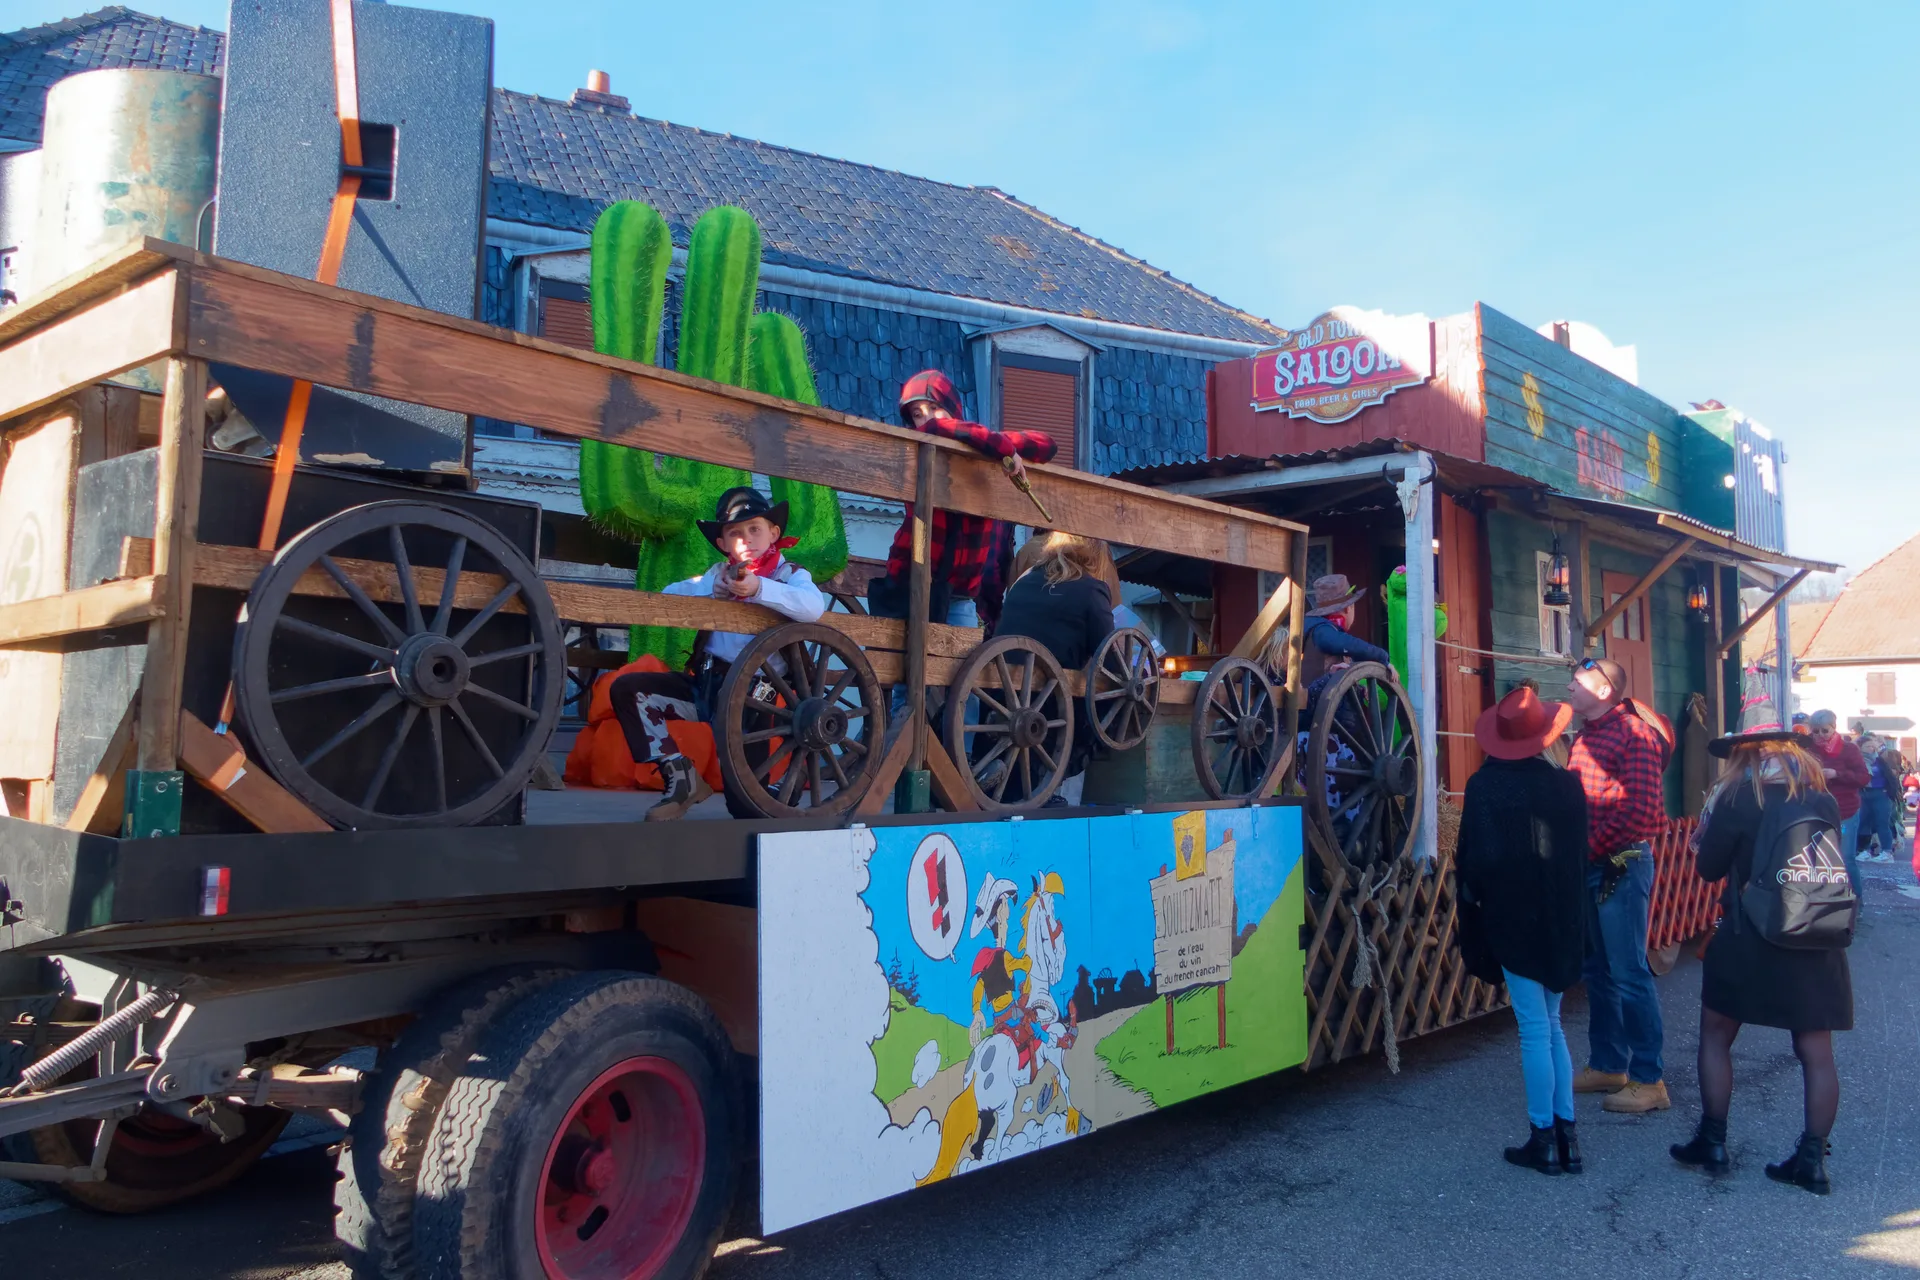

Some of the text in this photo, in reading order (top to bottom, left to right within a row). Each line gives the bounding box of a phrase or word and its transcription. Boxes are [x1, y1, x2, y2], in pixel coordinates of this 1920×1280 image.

[1298, 319, 1360, 350] OLD TO
[1319, 394, 1340, 405] BEER
[1342, 392, 1349, 401] &
[1351, 387, 1378, 399] GIRLS
[1776, 868, 1849, 885] adida
[1162, 876, 1223, 938] SOULTZMATT
[1177, 945, 1187, 957] de
[1179, 956, 1202, 969] du vin
[1164, 964, 1221, 985] du french cancan
